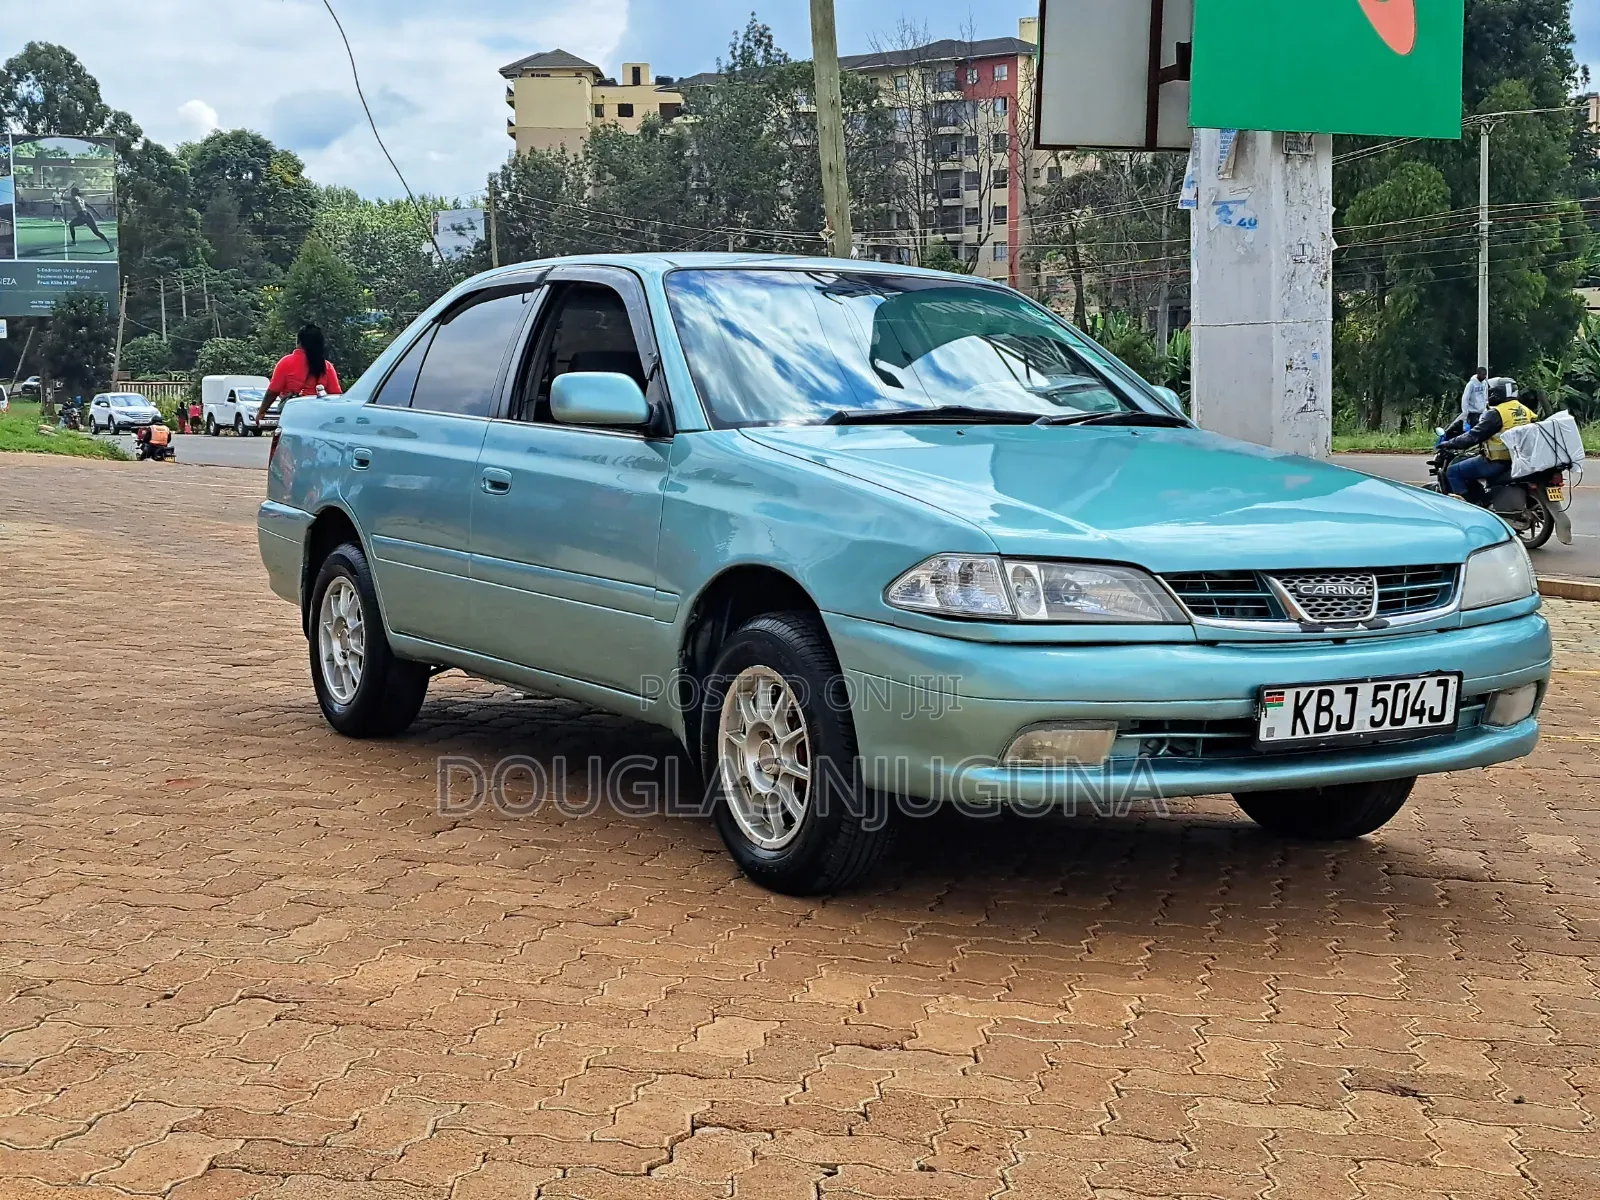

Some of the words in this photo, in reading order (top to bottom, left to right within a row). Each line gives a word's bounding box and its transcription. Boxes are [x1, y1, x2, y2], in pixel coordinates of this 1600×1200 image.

[1299, 584, 1367, 595] CARINA
[1291, 686, 1359, 736] KBJ
[1369, 678, 1450, 728] 504J
